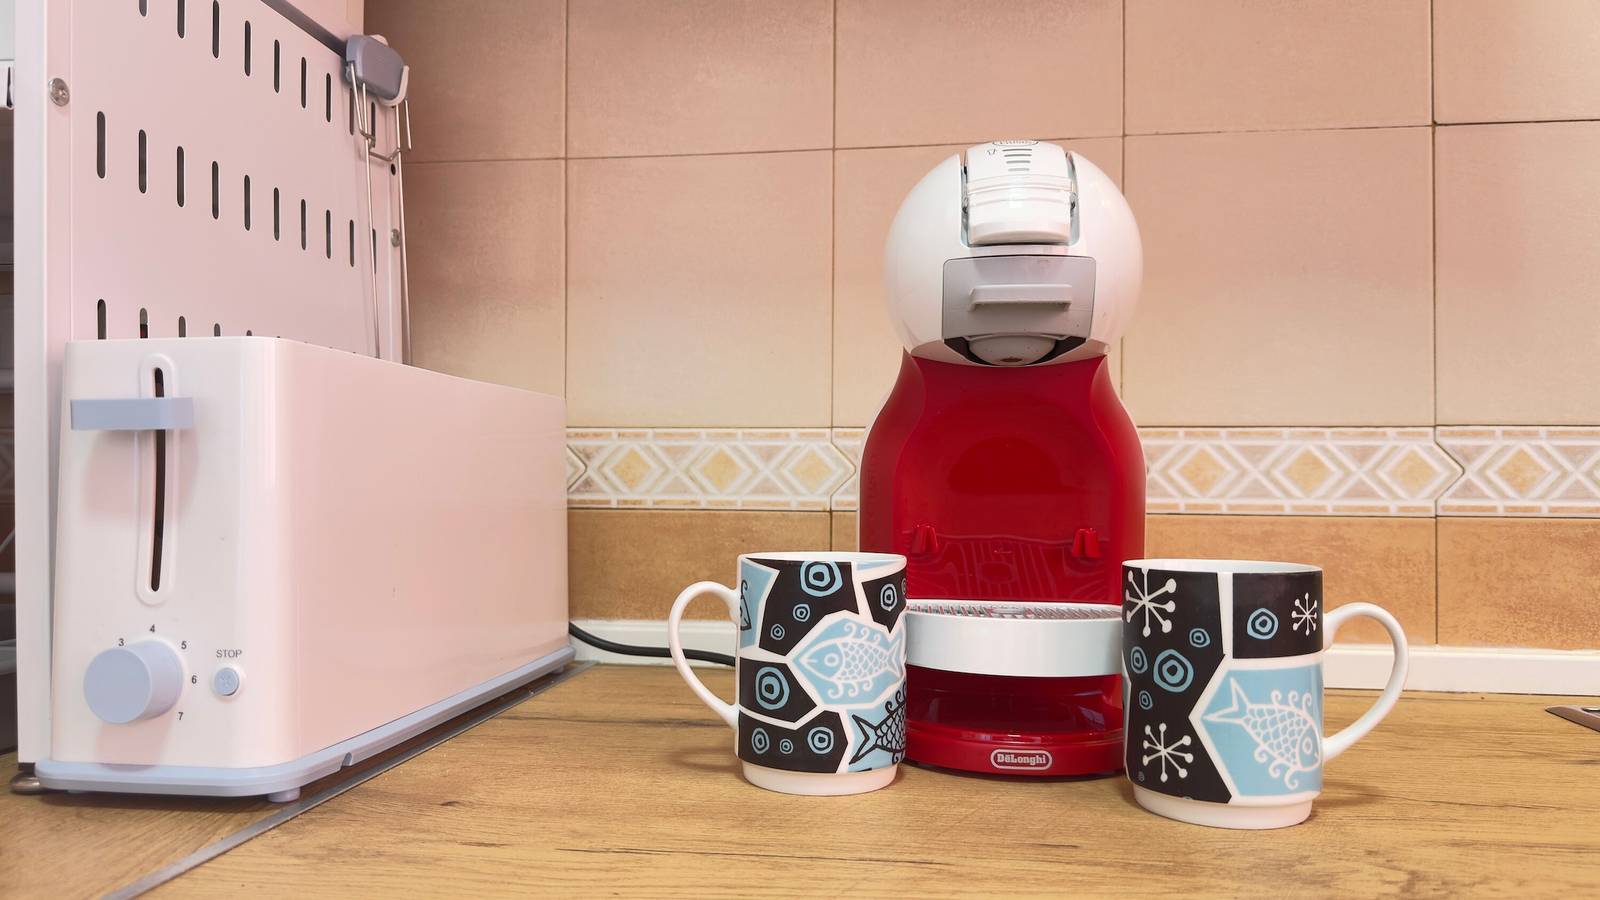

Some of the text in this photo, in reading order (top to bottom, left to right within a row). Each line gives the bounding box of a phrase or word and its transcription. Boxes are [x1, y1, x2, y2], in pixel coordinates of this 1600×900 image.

[149, 624, 156, 633] 4
[118, 638, 125, 647] 3
[181, 641, 187, 650] 5
[216, 649, 243, 659] STOP
[191, 675, 197, 684] 6
[178, 711, 184, 720] 7
